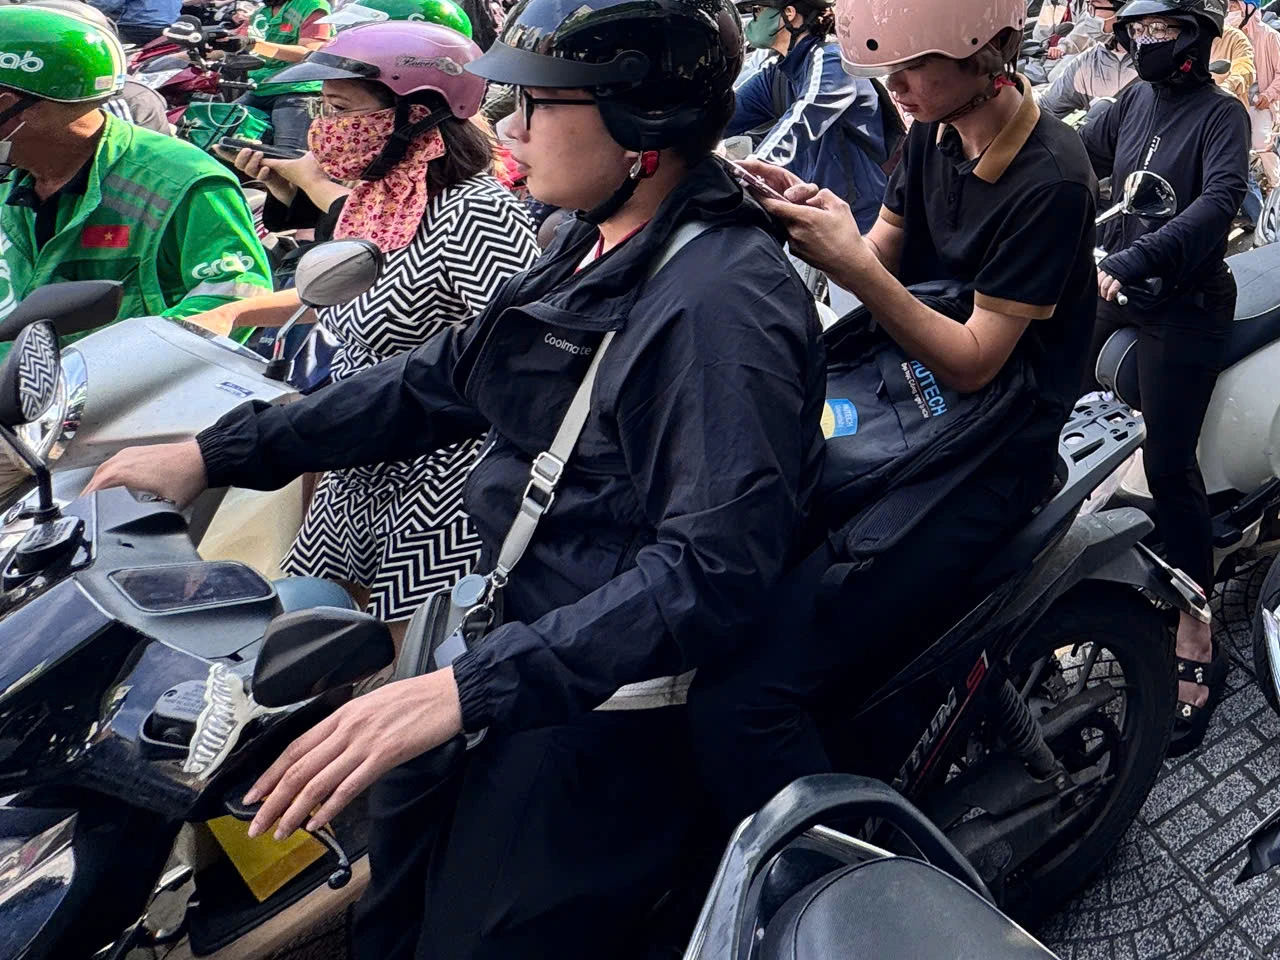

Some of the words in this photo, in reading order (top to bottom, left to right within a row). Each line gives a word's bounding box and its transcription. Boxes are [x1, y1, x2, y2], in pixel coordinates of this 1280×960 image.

[0, 50, 44, 72] ab
[192, 250, 255, 279] Grab
[544, 332, 592, 355] Coolmate
